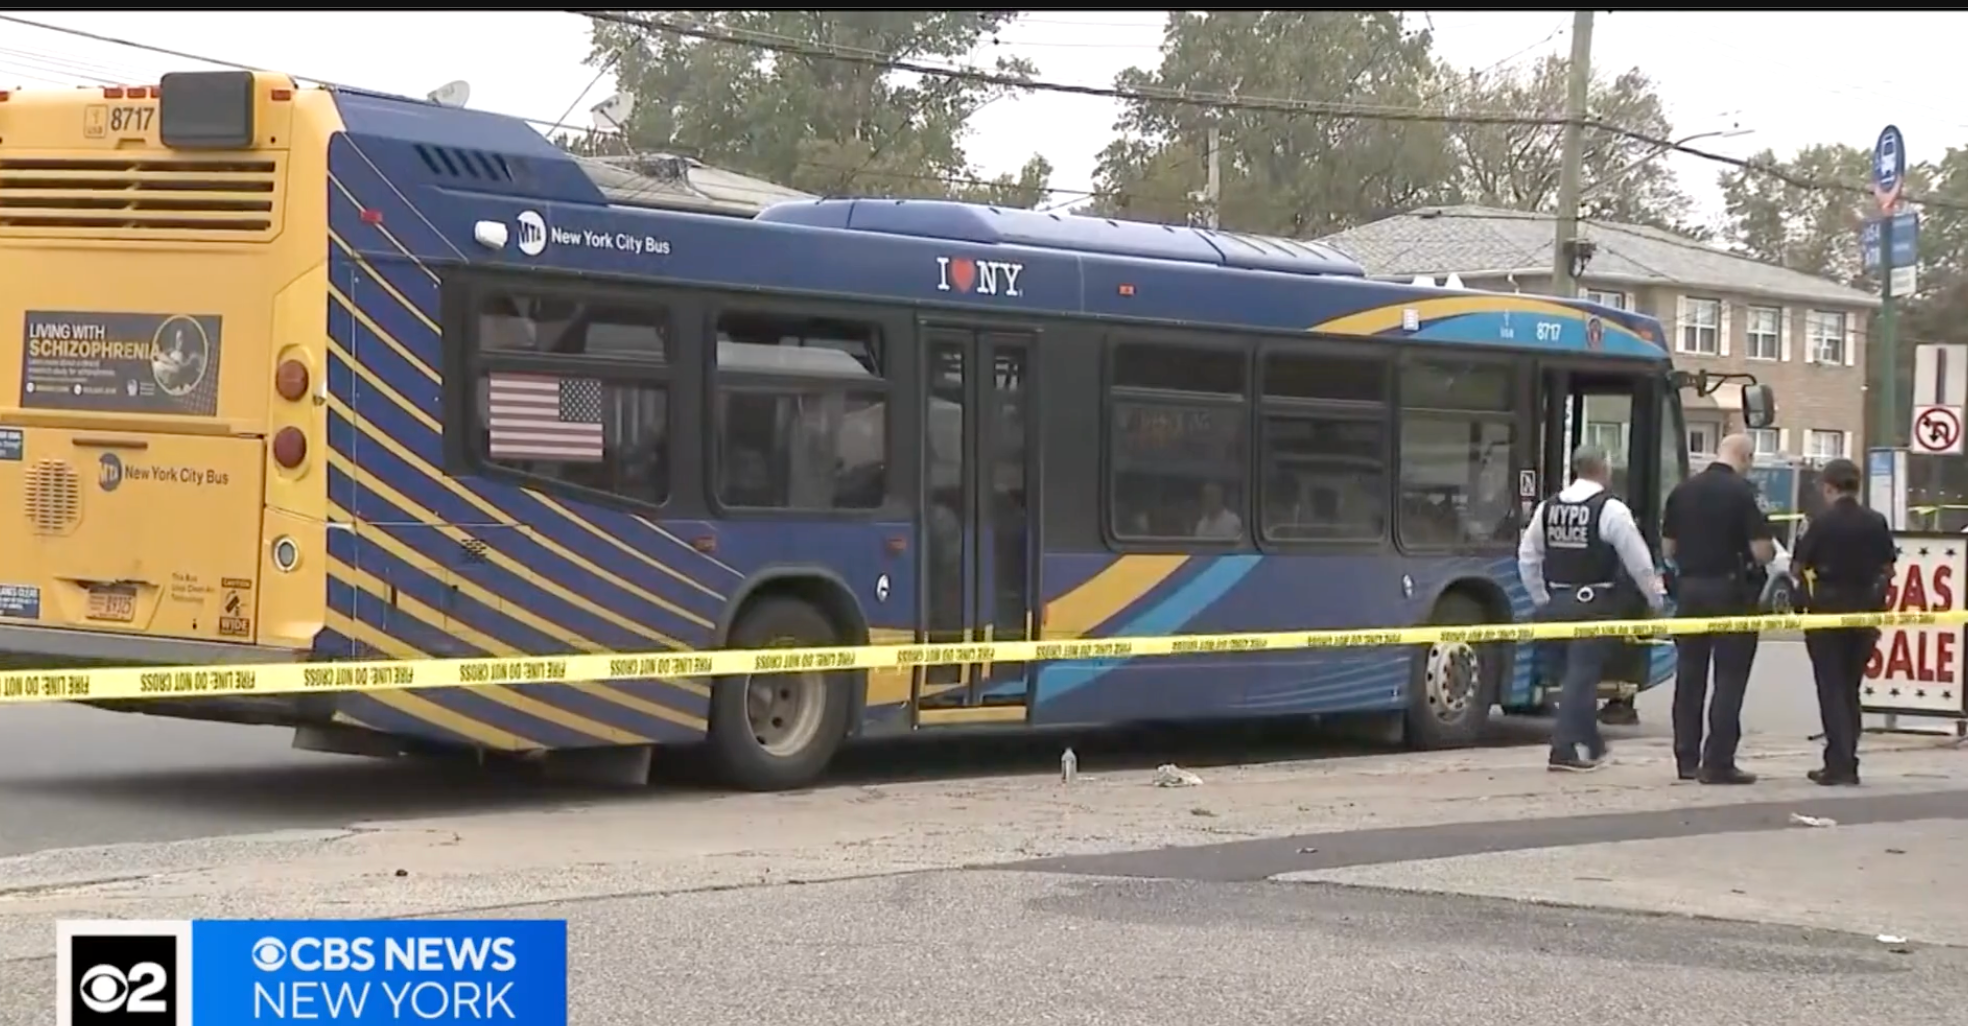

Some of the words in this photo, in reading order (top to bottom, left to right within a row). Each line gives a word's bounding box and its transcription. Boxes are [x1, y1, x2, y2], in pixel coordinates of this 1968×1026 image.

[110, 106, 155, 131] 8717
[551, 226, 581, 245] New
[583, 230, 614, 249] York
[615, 233, 643, 254] City
[645, 236, 670, 254] Bus
[936, 257, 950, 291] I
[976, 260, 1022, 296] NY
[29, 323, 70, 339] LIVING
[72, 324, 105, 340] WITH
[1536, 322, 1561, 341] 8717
[29, 339, 161, 360] SCHIZOPHRENIA
[125, 464, 150, 480] New
[151, 465, 178, 482] York
[180, 467, 204, 486] City
[206, 468, 229, 486] Bus
[1549, 505, 1590, 525] NYPD
[1548, 526, 1588, 542] POLICE
[1864, 629, 1955, 683] SALE
[140, 672, 172, 692] CROSS
[174, 672, 193, 692] NOT
[194, 671, 208, 691] DO
[235, 670, 256, 690] FIRE
